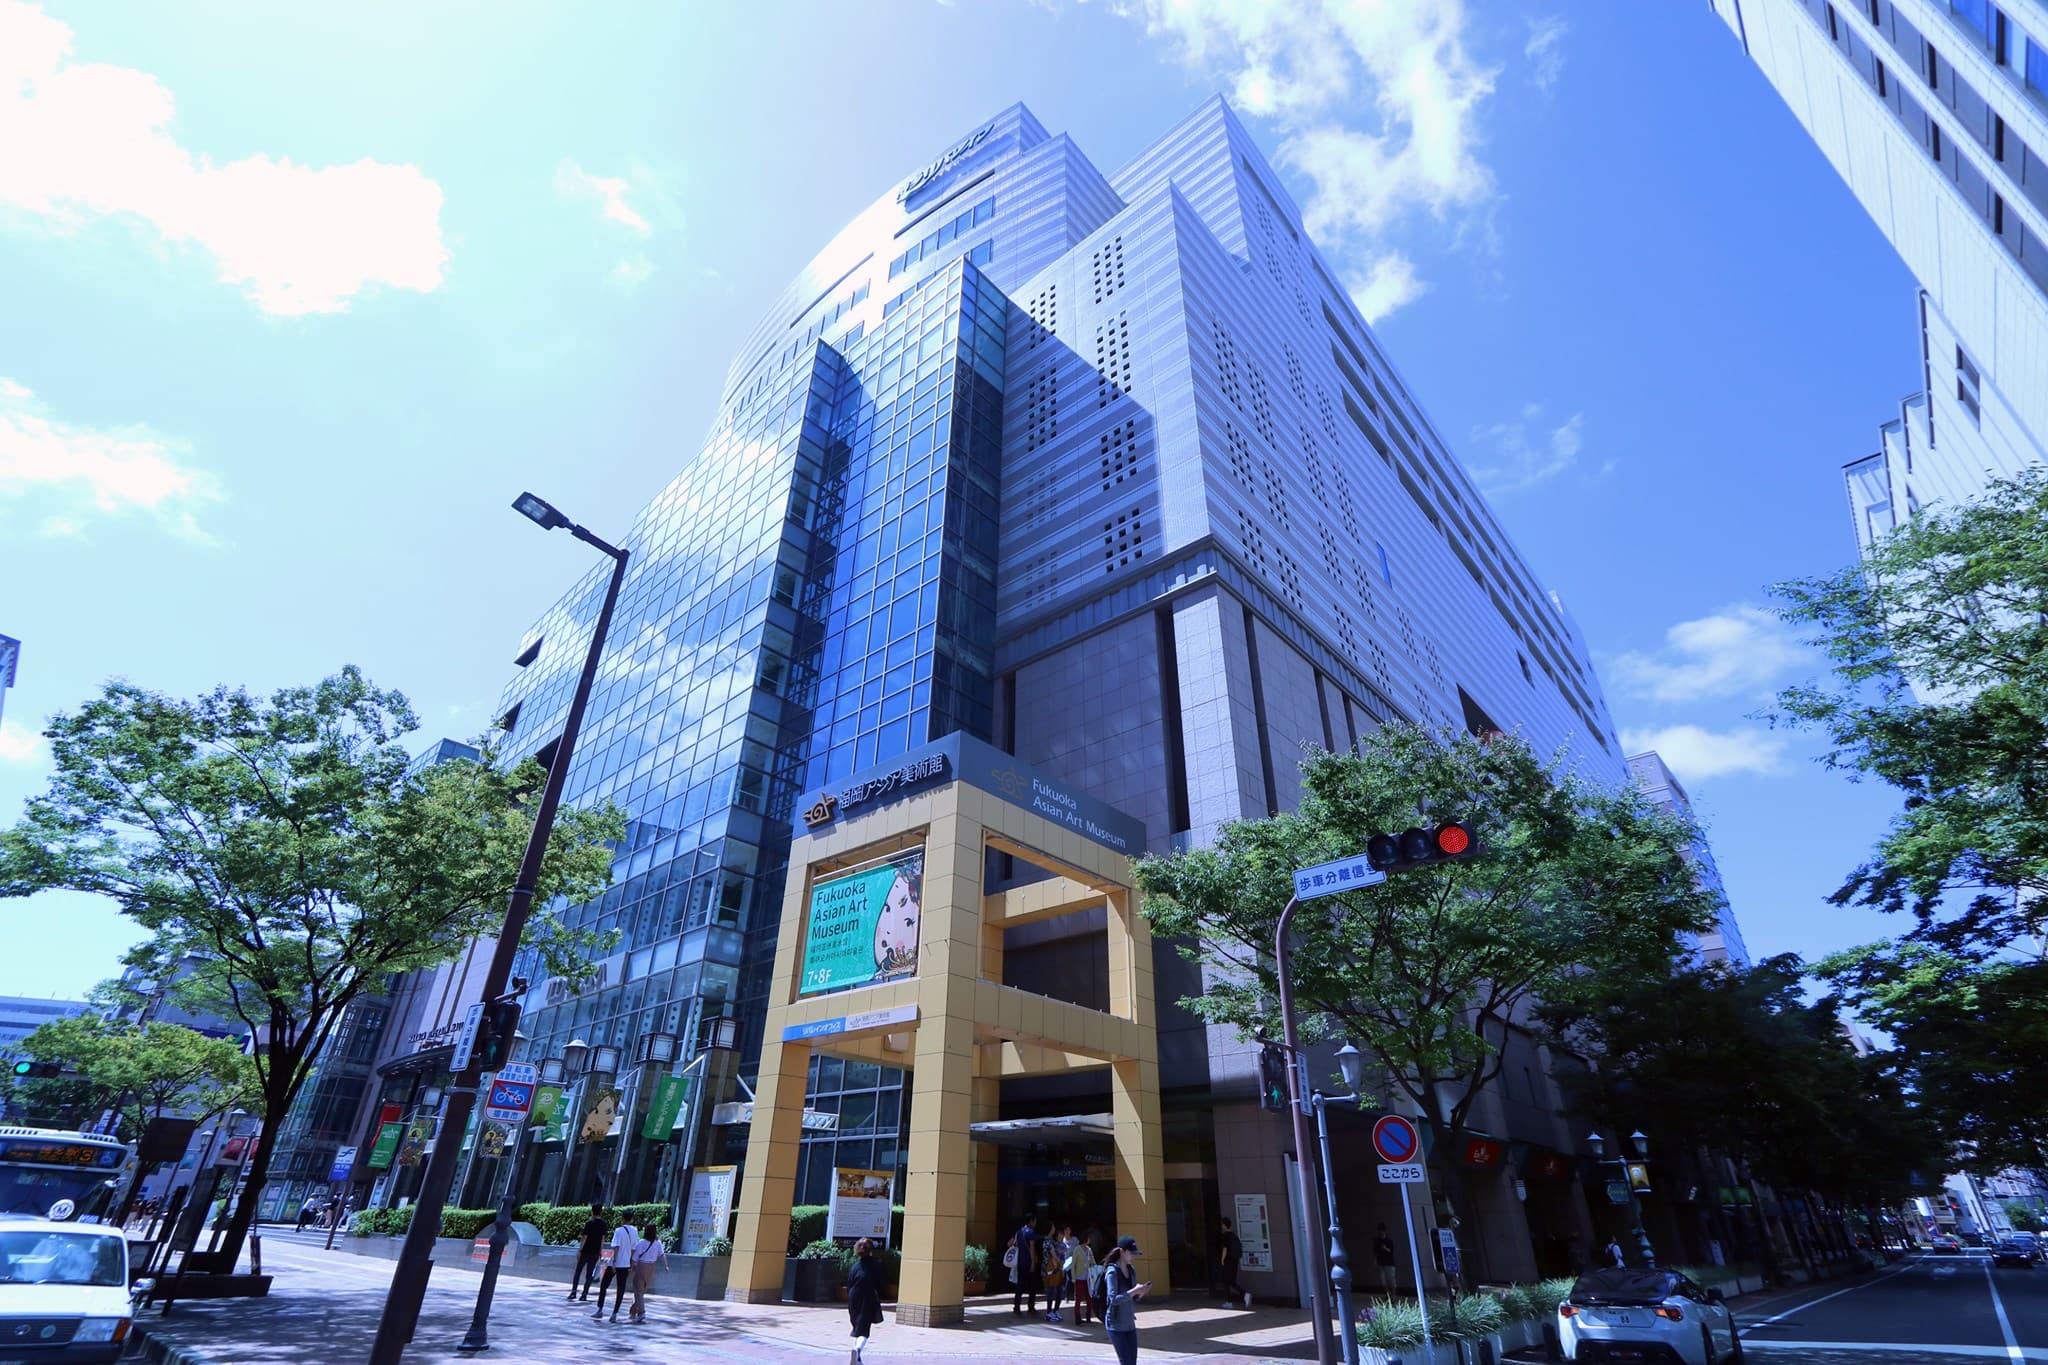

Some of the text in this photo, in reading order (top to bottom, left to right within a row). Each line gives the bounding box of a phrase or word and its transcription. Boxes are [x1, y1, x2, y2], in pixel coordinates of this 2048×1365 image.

[839, 752, 943, 809] 福岡アジア美術館
[1033, 778, 1077, 810] Fukuoka
[1033, 796, 1126, 849] Asian Art Museum
[816, 881, 866, 906] Fukuoka
[814, 897, 868, 923] Asian Art
[811, 918, 859, 941] Museum
[1381, 1168, 1420, 1179] ここから
